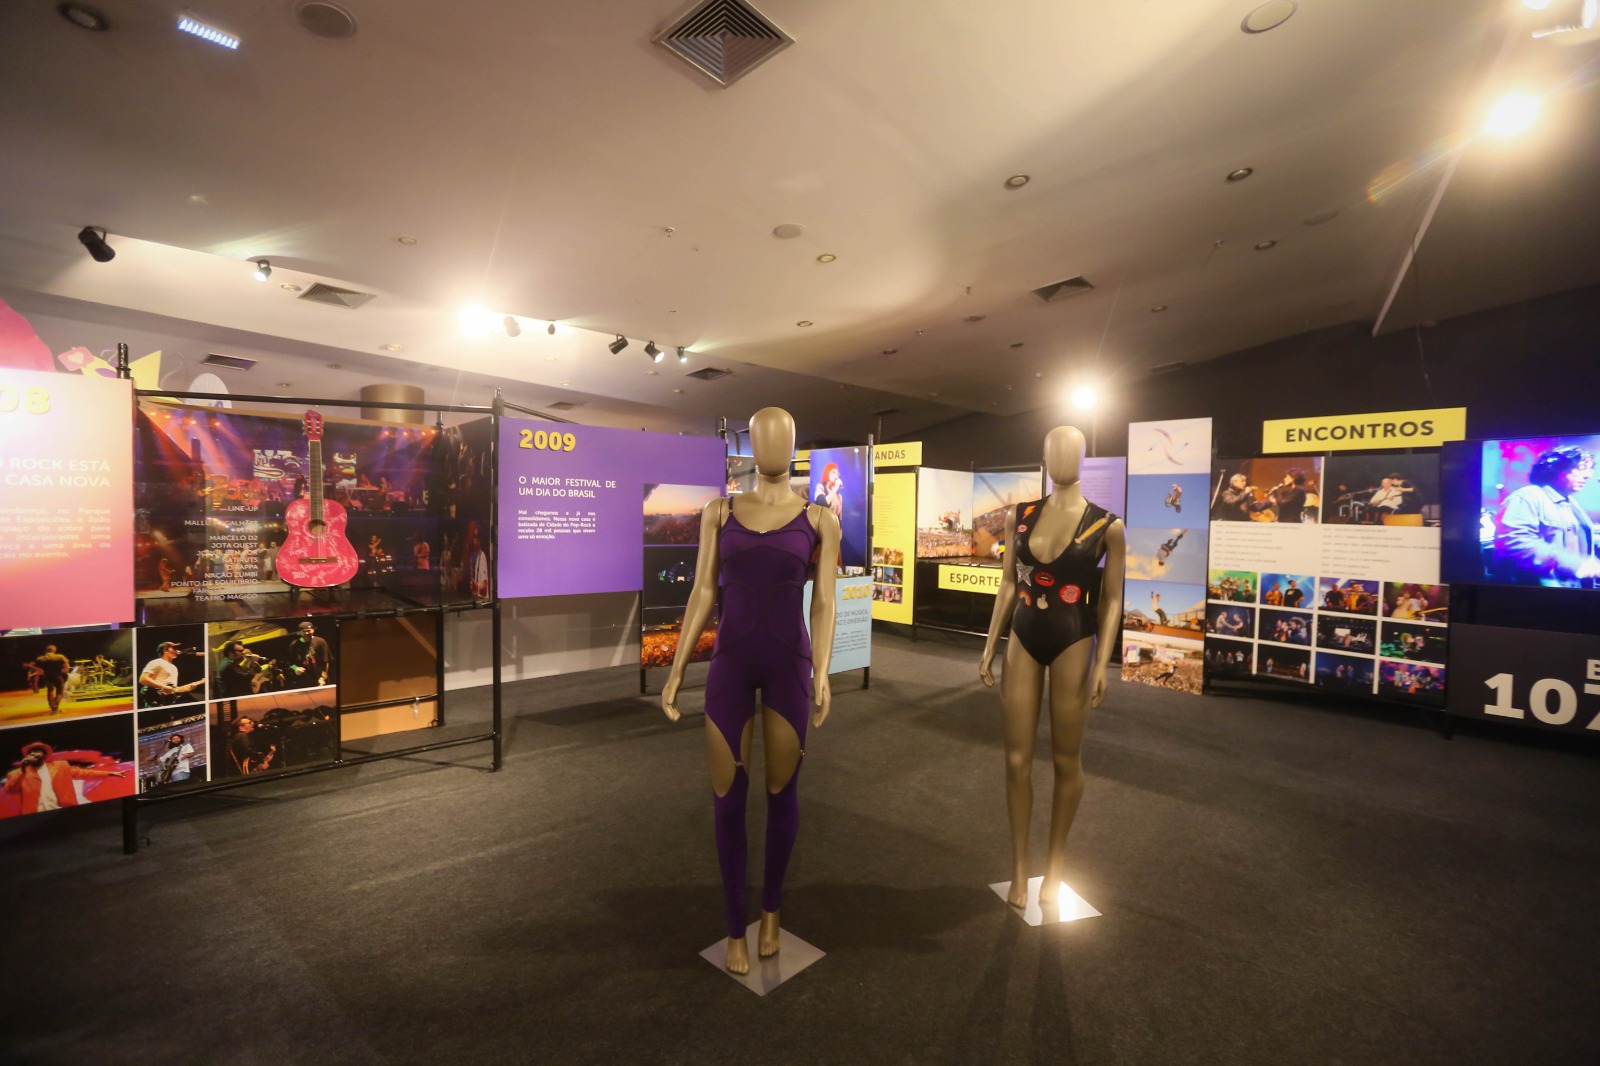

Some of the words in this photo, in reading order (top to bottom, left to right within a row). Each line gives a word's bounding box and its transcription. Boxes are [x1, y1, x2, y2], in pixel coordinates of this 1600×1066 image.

[1285, 420, 1435, 442] ENCONTROS
[519, 428, 576, 452] 2009
[10, 458, 63, 470] ROCK
[69, 459, 111, 472] ESTÁ
[5, 474, 54, 486] CASA
[60, 476, 111, 488] NOVA
[518, 476, 526, 484] O
[532, 476, 561, 486] MAIOR
[565, 478, 602, 488] FESTIVAL
[606, 480, 616, 488] DE
[518, 488, 534, 496] UM
[536, 488, 550, 496] DIA
[552, 488, 566, 497] DO
[568, 490, 596, 498] BRASIL
[950, 573, 1000, 587] ESPORTE
[842, 583, 871, 600] 2010
[847, 616, 869, 625] DIVERSÃO
